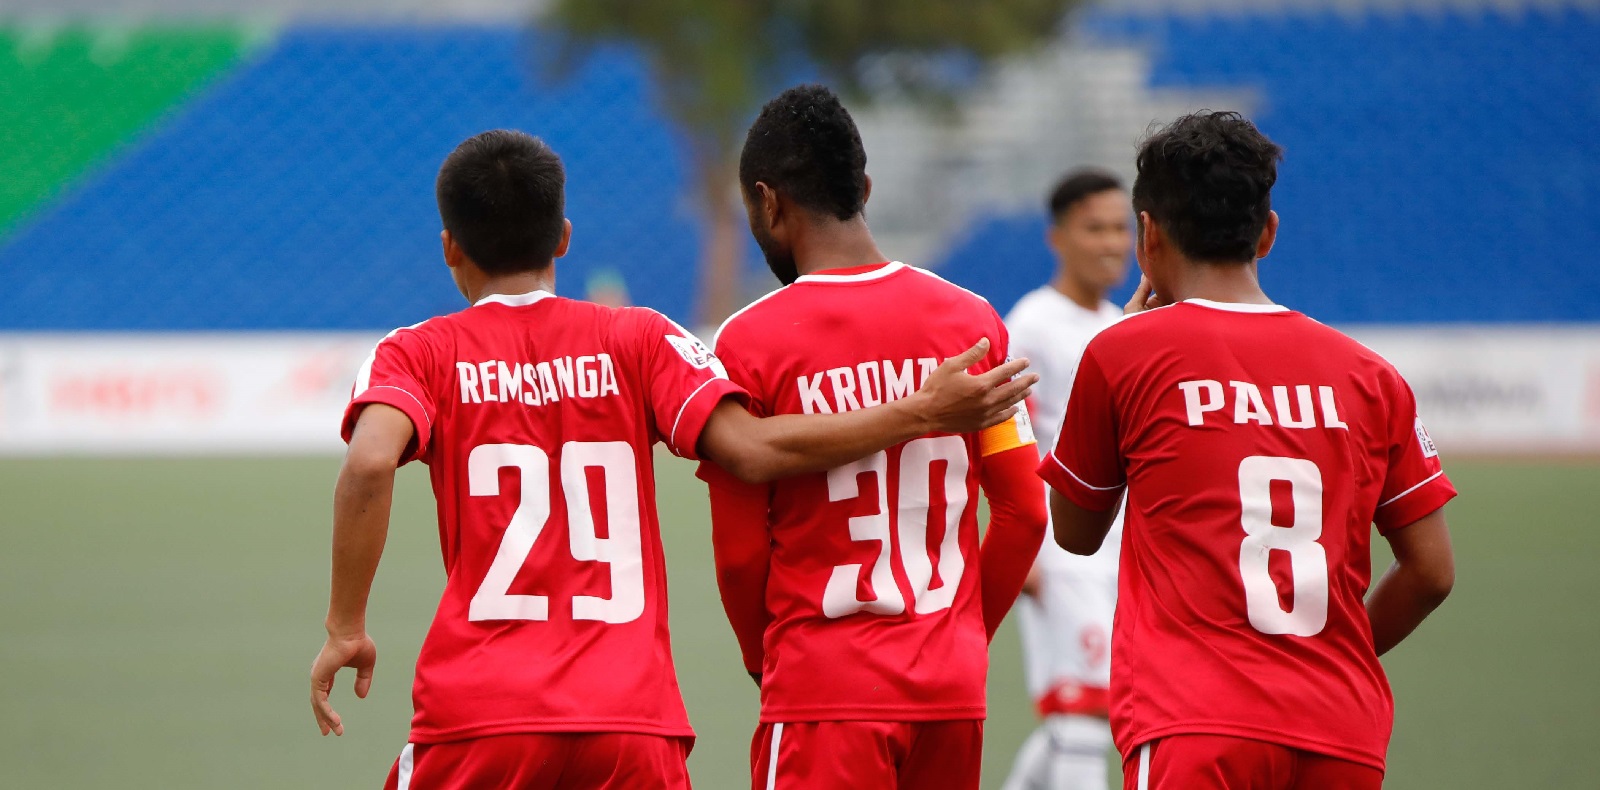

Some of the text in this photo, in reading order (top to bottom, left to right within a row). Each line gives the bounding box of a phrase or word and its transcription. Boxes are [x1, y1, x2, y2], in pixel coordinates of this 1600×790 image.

[456, 353, 620, 406] REMSANGA
[797, 357, 968, 416] KROMA
[1178, 379, 1349, 431] PAUL
[467, 440, 645, 624] 29
[822, 435, 969, 619] 30
[1238, 455, 1329, 637] 8
